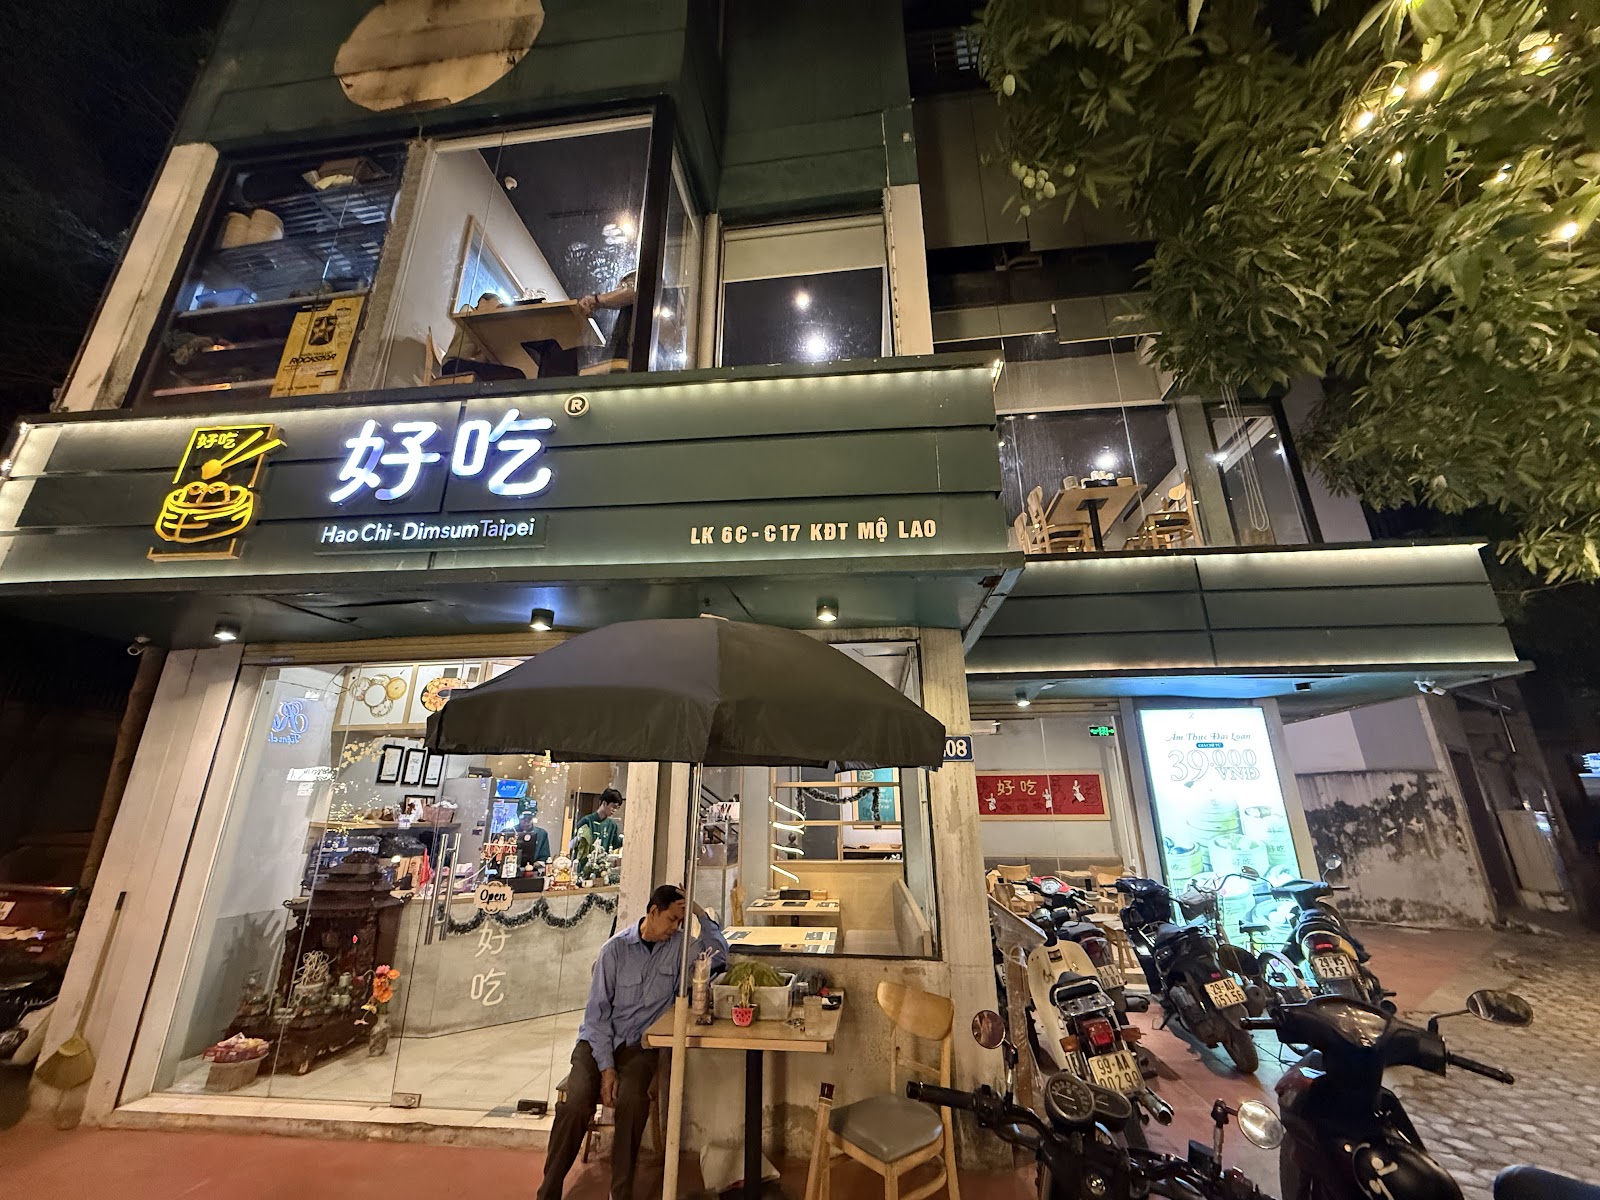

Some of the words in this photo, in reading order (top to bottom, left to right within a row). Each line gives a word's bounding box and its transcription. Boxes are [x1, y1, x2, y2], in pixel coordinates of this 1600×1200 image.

[196, 432, 238, 449] 好吃
[329, 408, 555, 503] 好吃
[321, 525, 359, 544] Hao
[690, 526, 715, 545] LK
[810, 522, 849, 542] KĐT
[857, 516, 888, 543] MỘ
[898, 519, 937, 539] LAO
[943, 739, 968, 757] 08
[996, 779, 1038, 796] 好吃
[479, 889, 508, 904] Open
[1096, 1053, 1131, 1076] 99-AA
